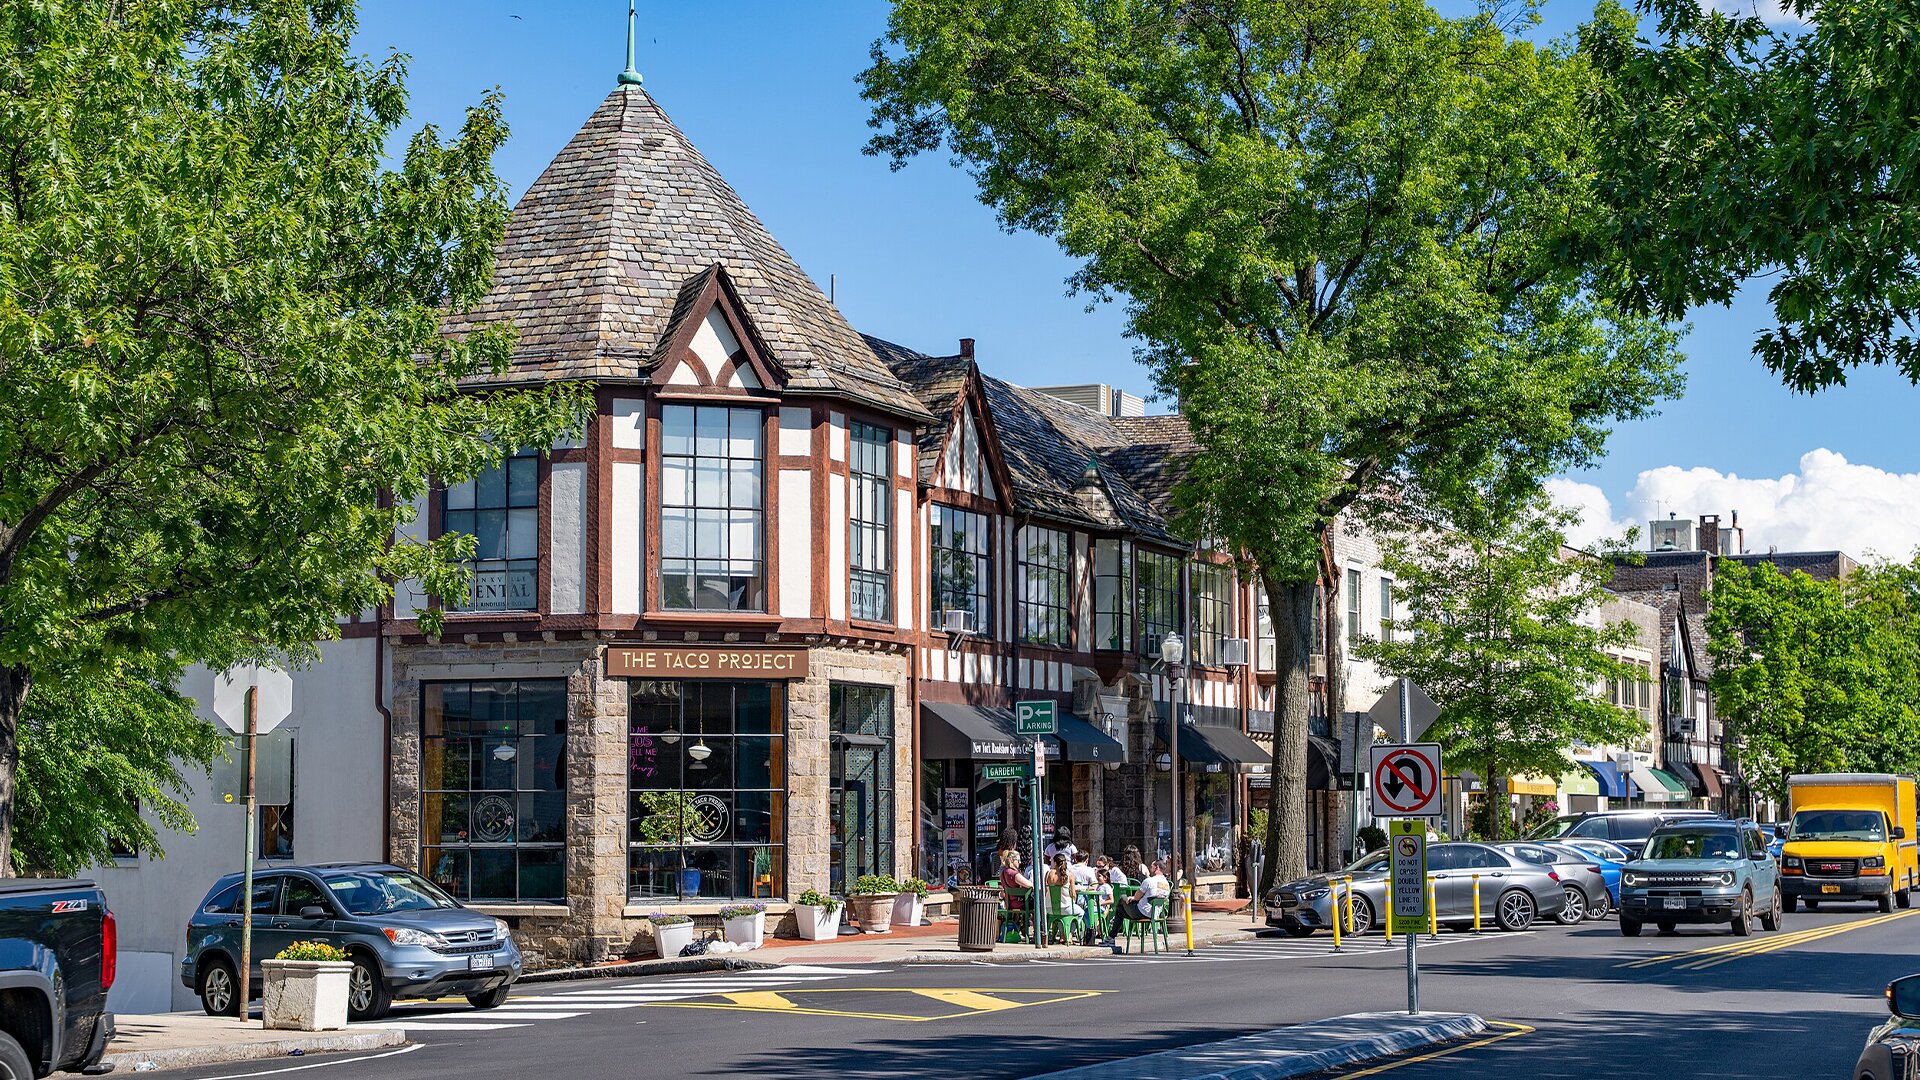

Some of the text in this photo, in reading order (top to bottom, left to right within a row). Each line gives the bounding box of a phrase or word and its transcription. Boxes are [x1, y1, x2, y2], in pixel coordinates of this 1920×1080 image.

[622, 652, 796, 670] THE TACO PROJECT
[645, 748, 657, 756] ME
[972, 741, 982, 754] New
[982, 741, 991, 754] York
[991, 742, 1010, 754] Roadshow
[1009, 743, 1023, 757] Sports
[990, 766, 1015, 776] GARDEN
[52, 899, 88, 914] Z71
